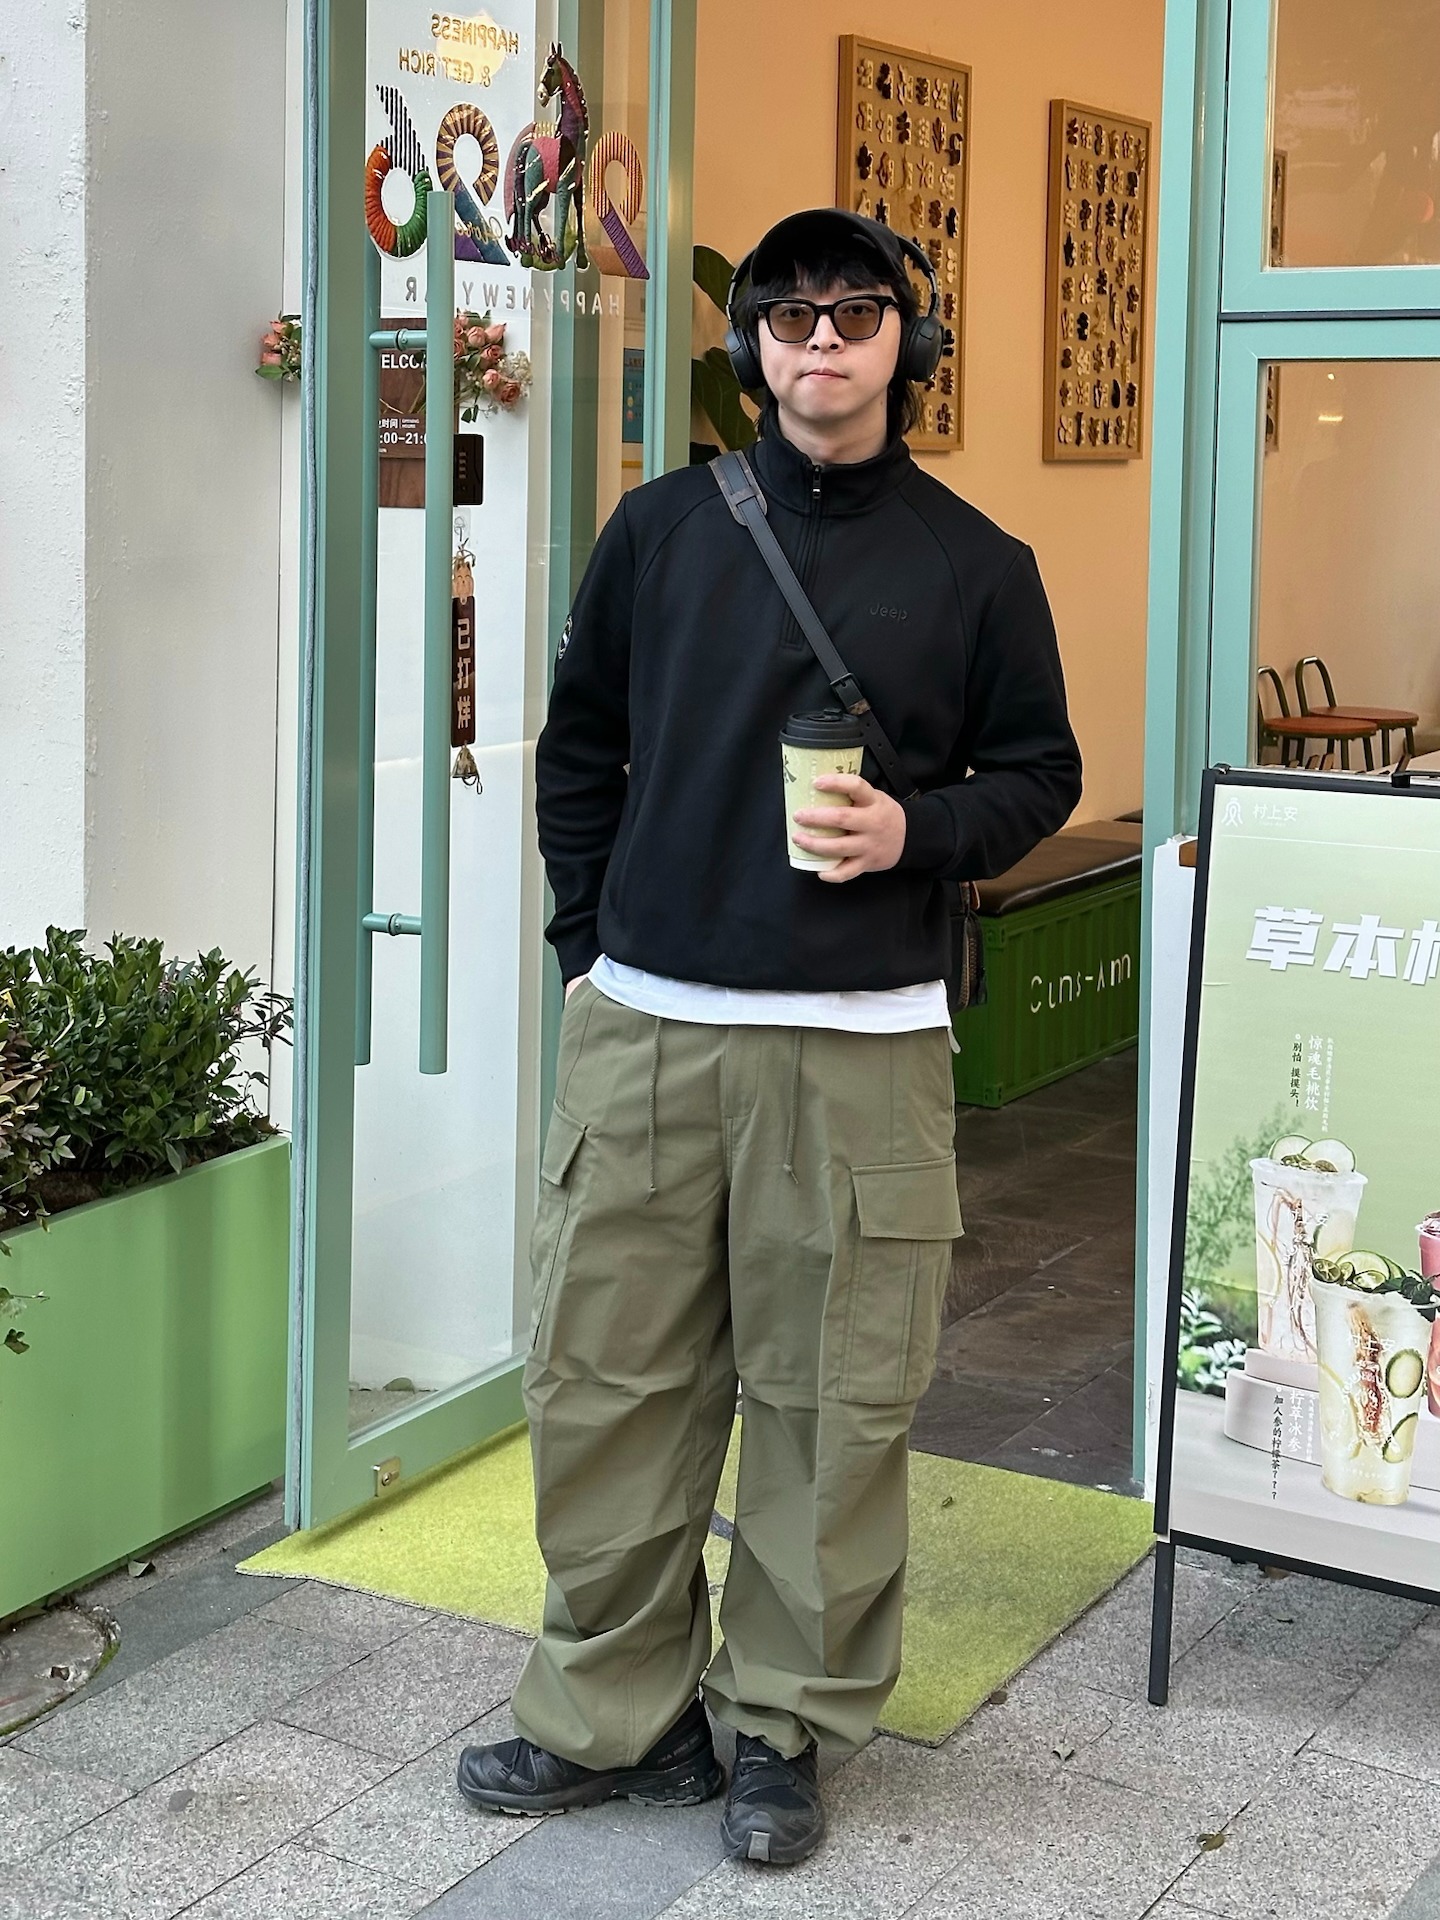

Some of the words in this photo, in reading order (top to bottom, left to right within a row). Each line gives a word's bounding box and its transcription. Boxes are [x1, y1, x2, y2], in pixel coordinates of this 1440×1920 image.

[381, 353, 427, 369] ELCO
[380, 432, 427, 445] :00-21:
[869, 602, 908, 623] Jeep
[457, 618, 471, 729] 已打烊
[1252, 803, 1298, 822] 村上安
[1304, 1035, 1323, 1111] 惊魂毛桃饮
